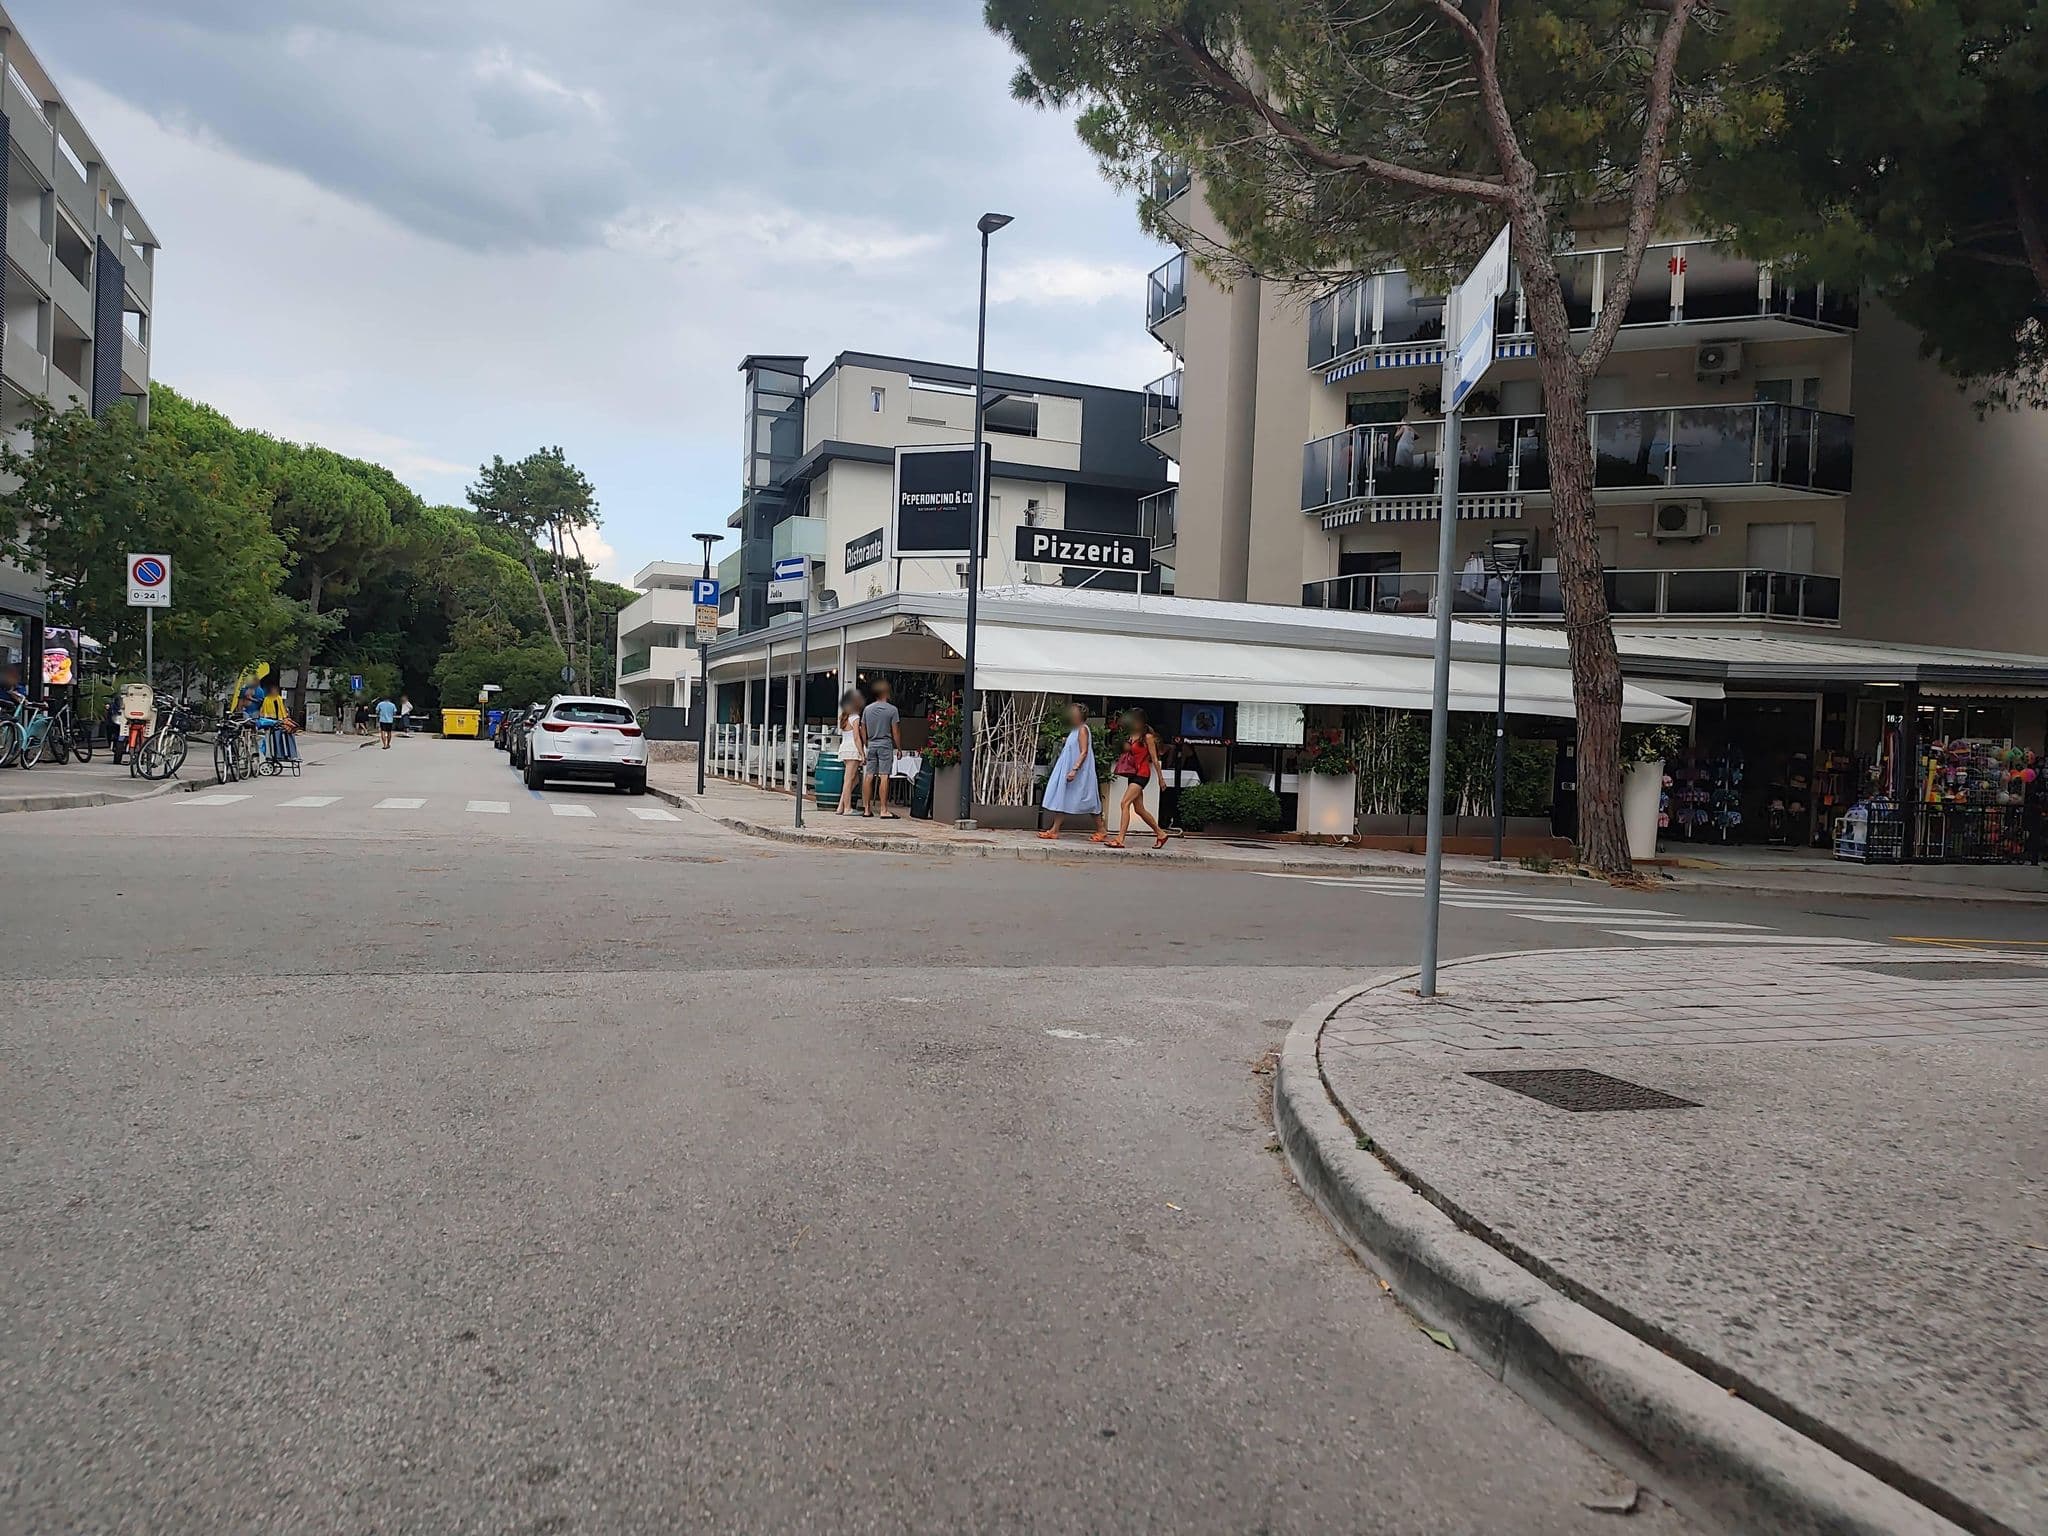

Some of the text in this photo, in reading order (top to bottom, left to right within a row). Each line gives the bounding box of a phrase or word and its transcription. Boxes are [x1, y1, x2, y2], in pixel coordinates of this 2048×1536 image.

[955, 491, 961, 504] &
[846, 538, 882, 568] Ristorante
[1033, 534, 1134, 564] Pizzeria
[698, 582, 714, 602] P
